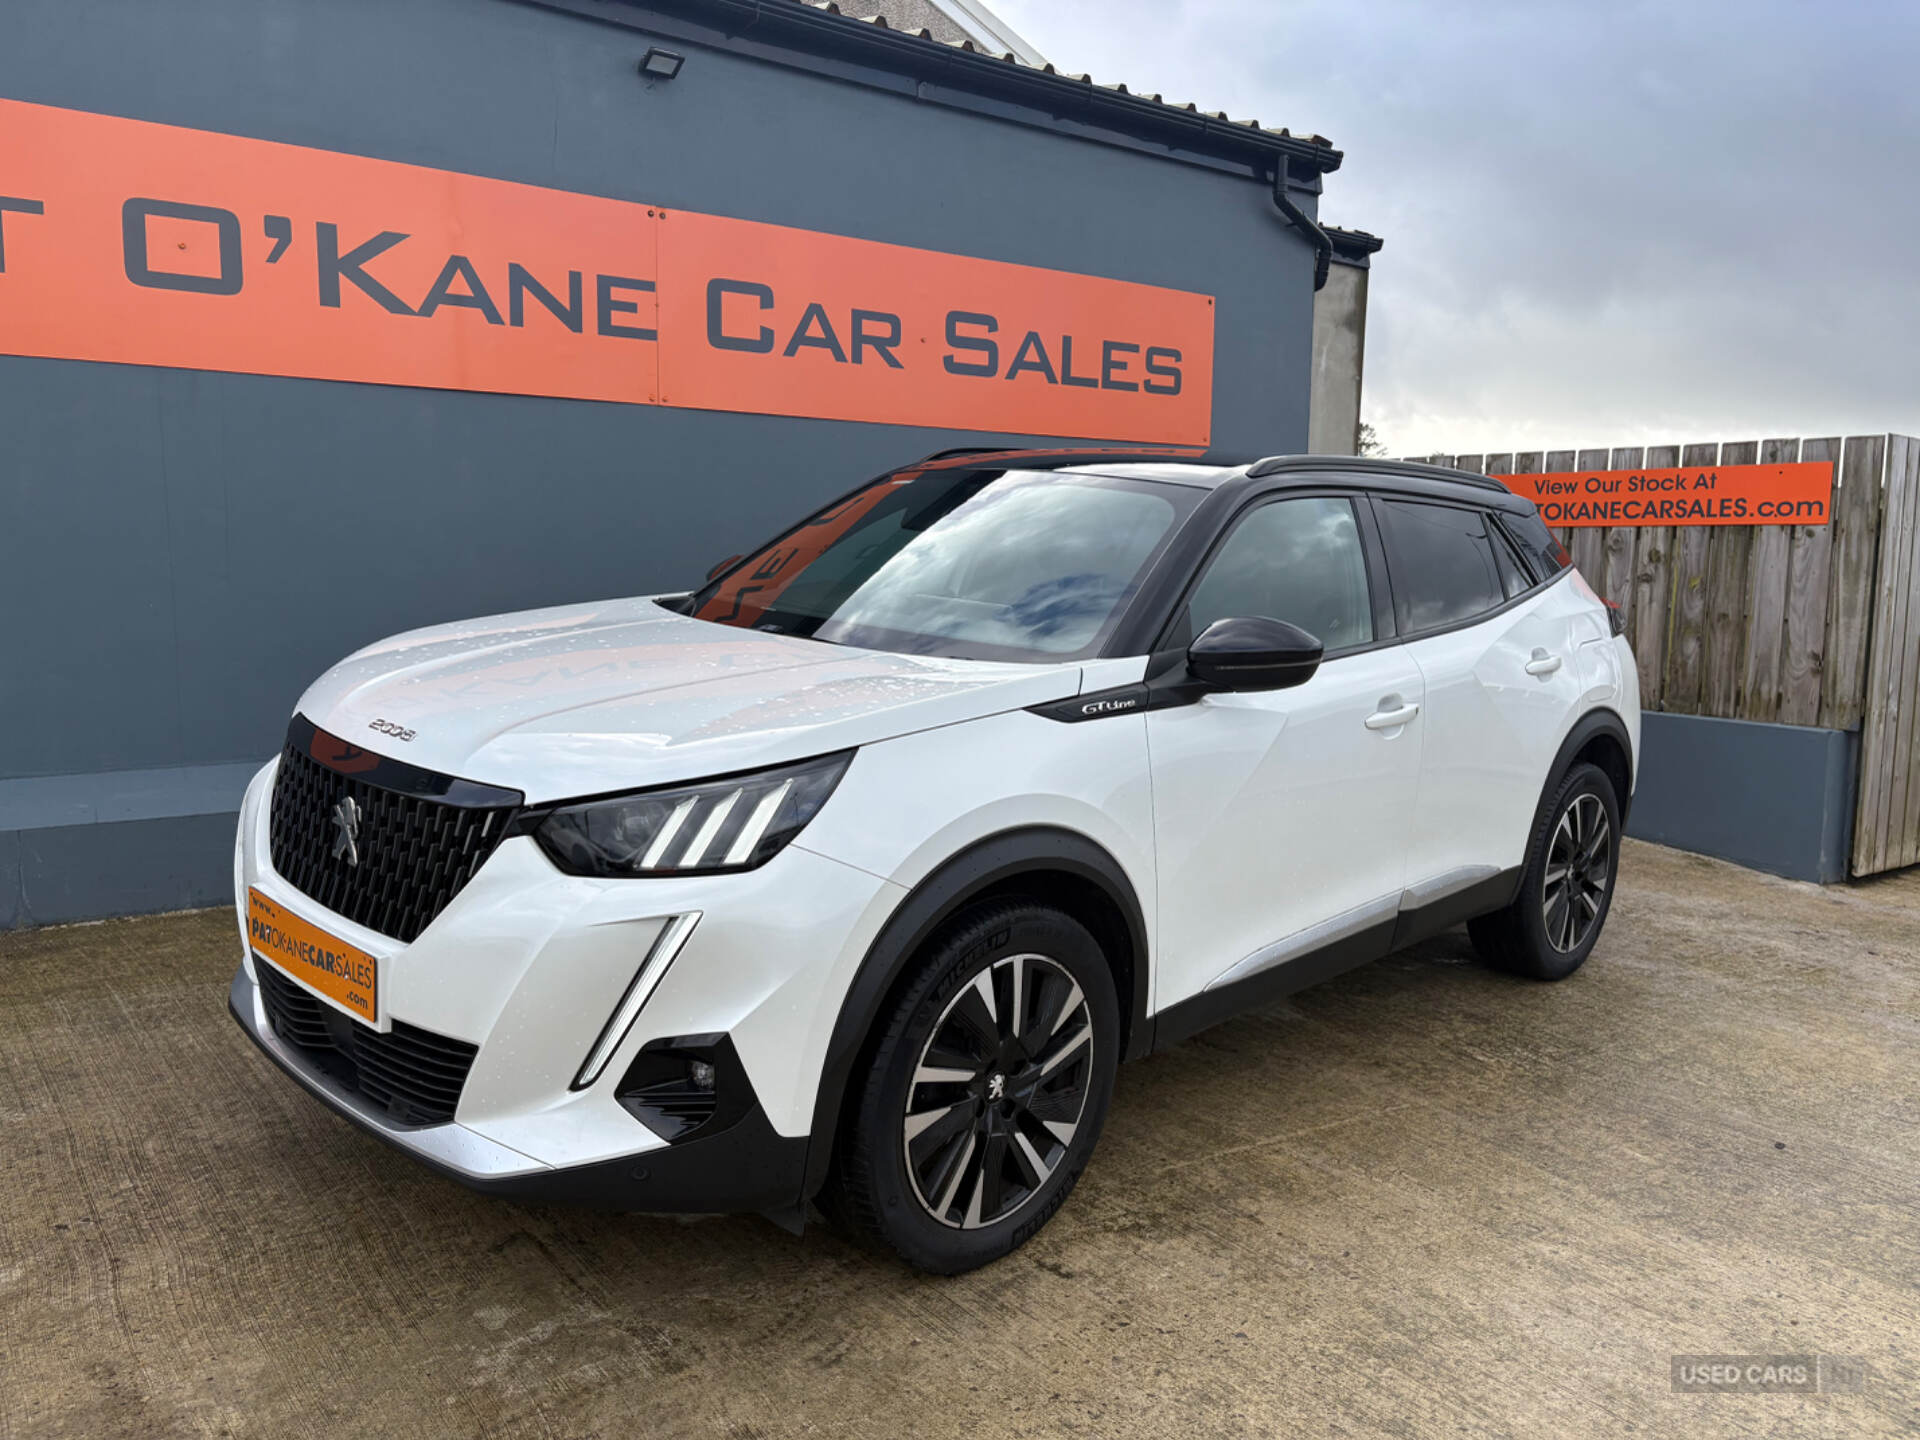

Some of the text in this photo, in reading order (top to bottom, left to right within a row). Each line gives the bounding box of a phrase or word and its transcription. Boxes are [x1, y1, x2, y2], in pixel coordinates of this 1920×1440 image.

[122, 196, 657, 341] O'KANE
[706, 278, 904, 369] CAR
[943, 310, 1183, 396] SALES
[1534, 473, 1718, 496] View Our Stock At
[368, 718, 417, 742] 2008
[252, 916, 373, 990] PATOKANECARSALES
[346, 990, 369, 1010] .com
